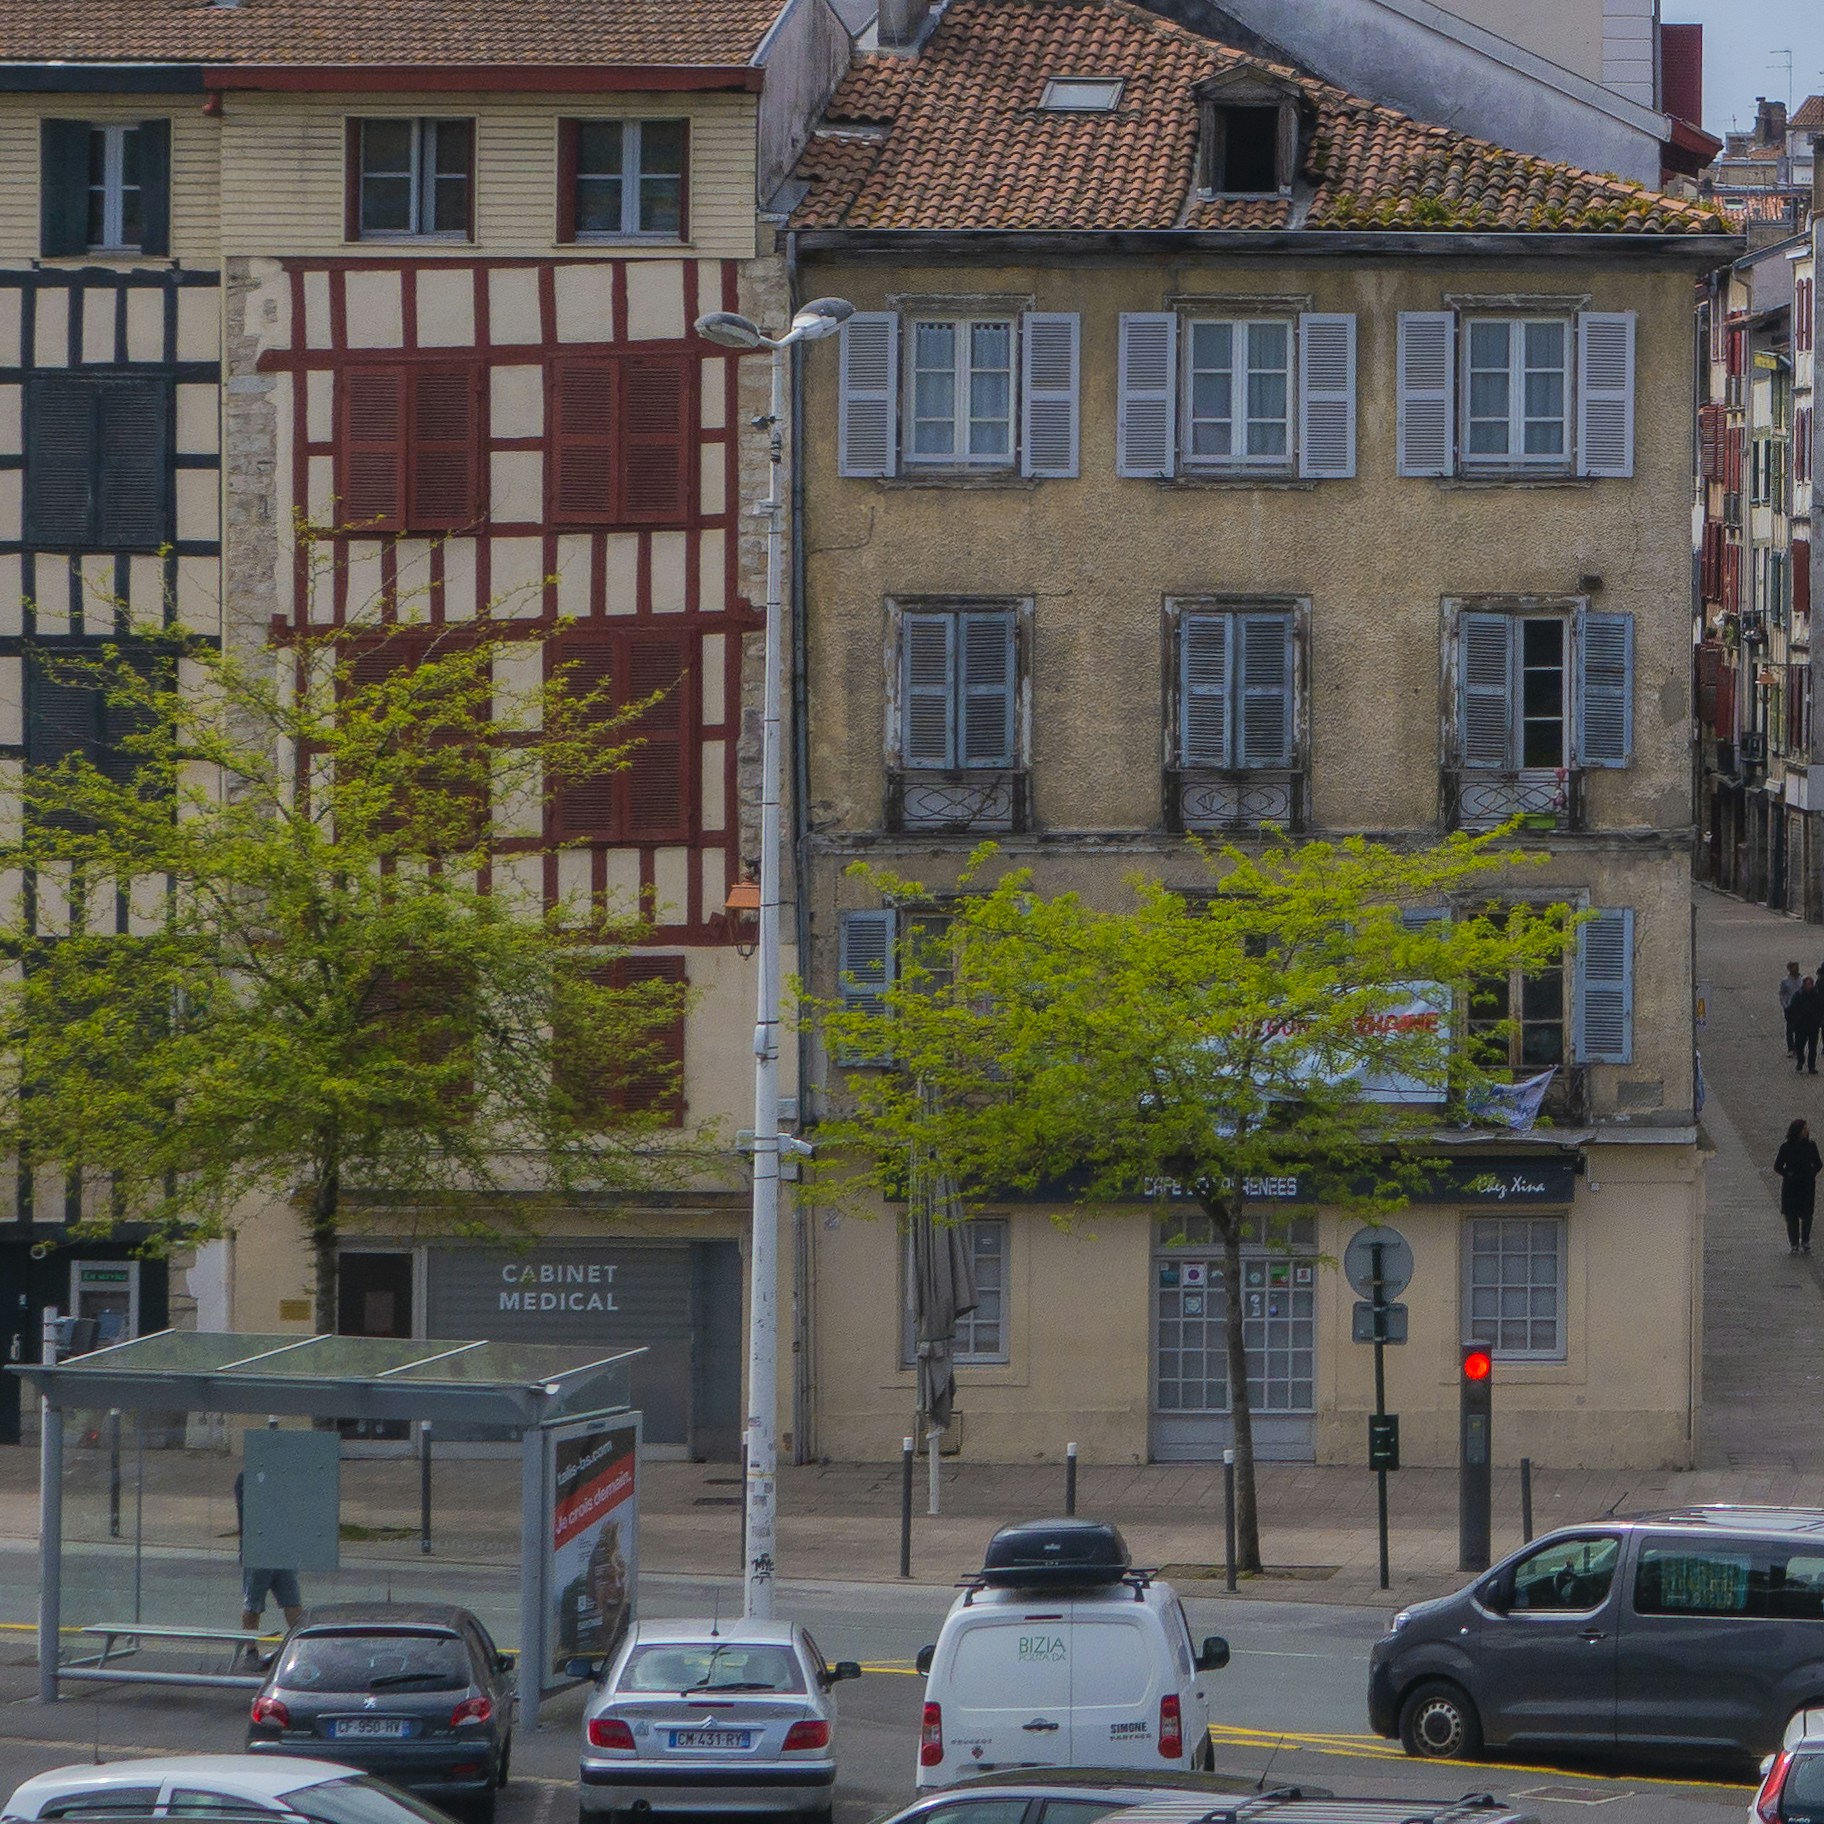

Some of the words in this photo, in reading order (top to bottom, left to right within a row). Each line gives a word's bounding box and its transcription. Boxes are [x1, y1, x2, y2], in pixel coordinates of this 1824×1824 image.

[502, 1263, 619, 1283] CABINET
[499, 1292, 620, 1311] MEDICAL
[1019, 1636, 1067, 1654] BIZIA
[1110, 1721, 1149, 1734] SIMONE
